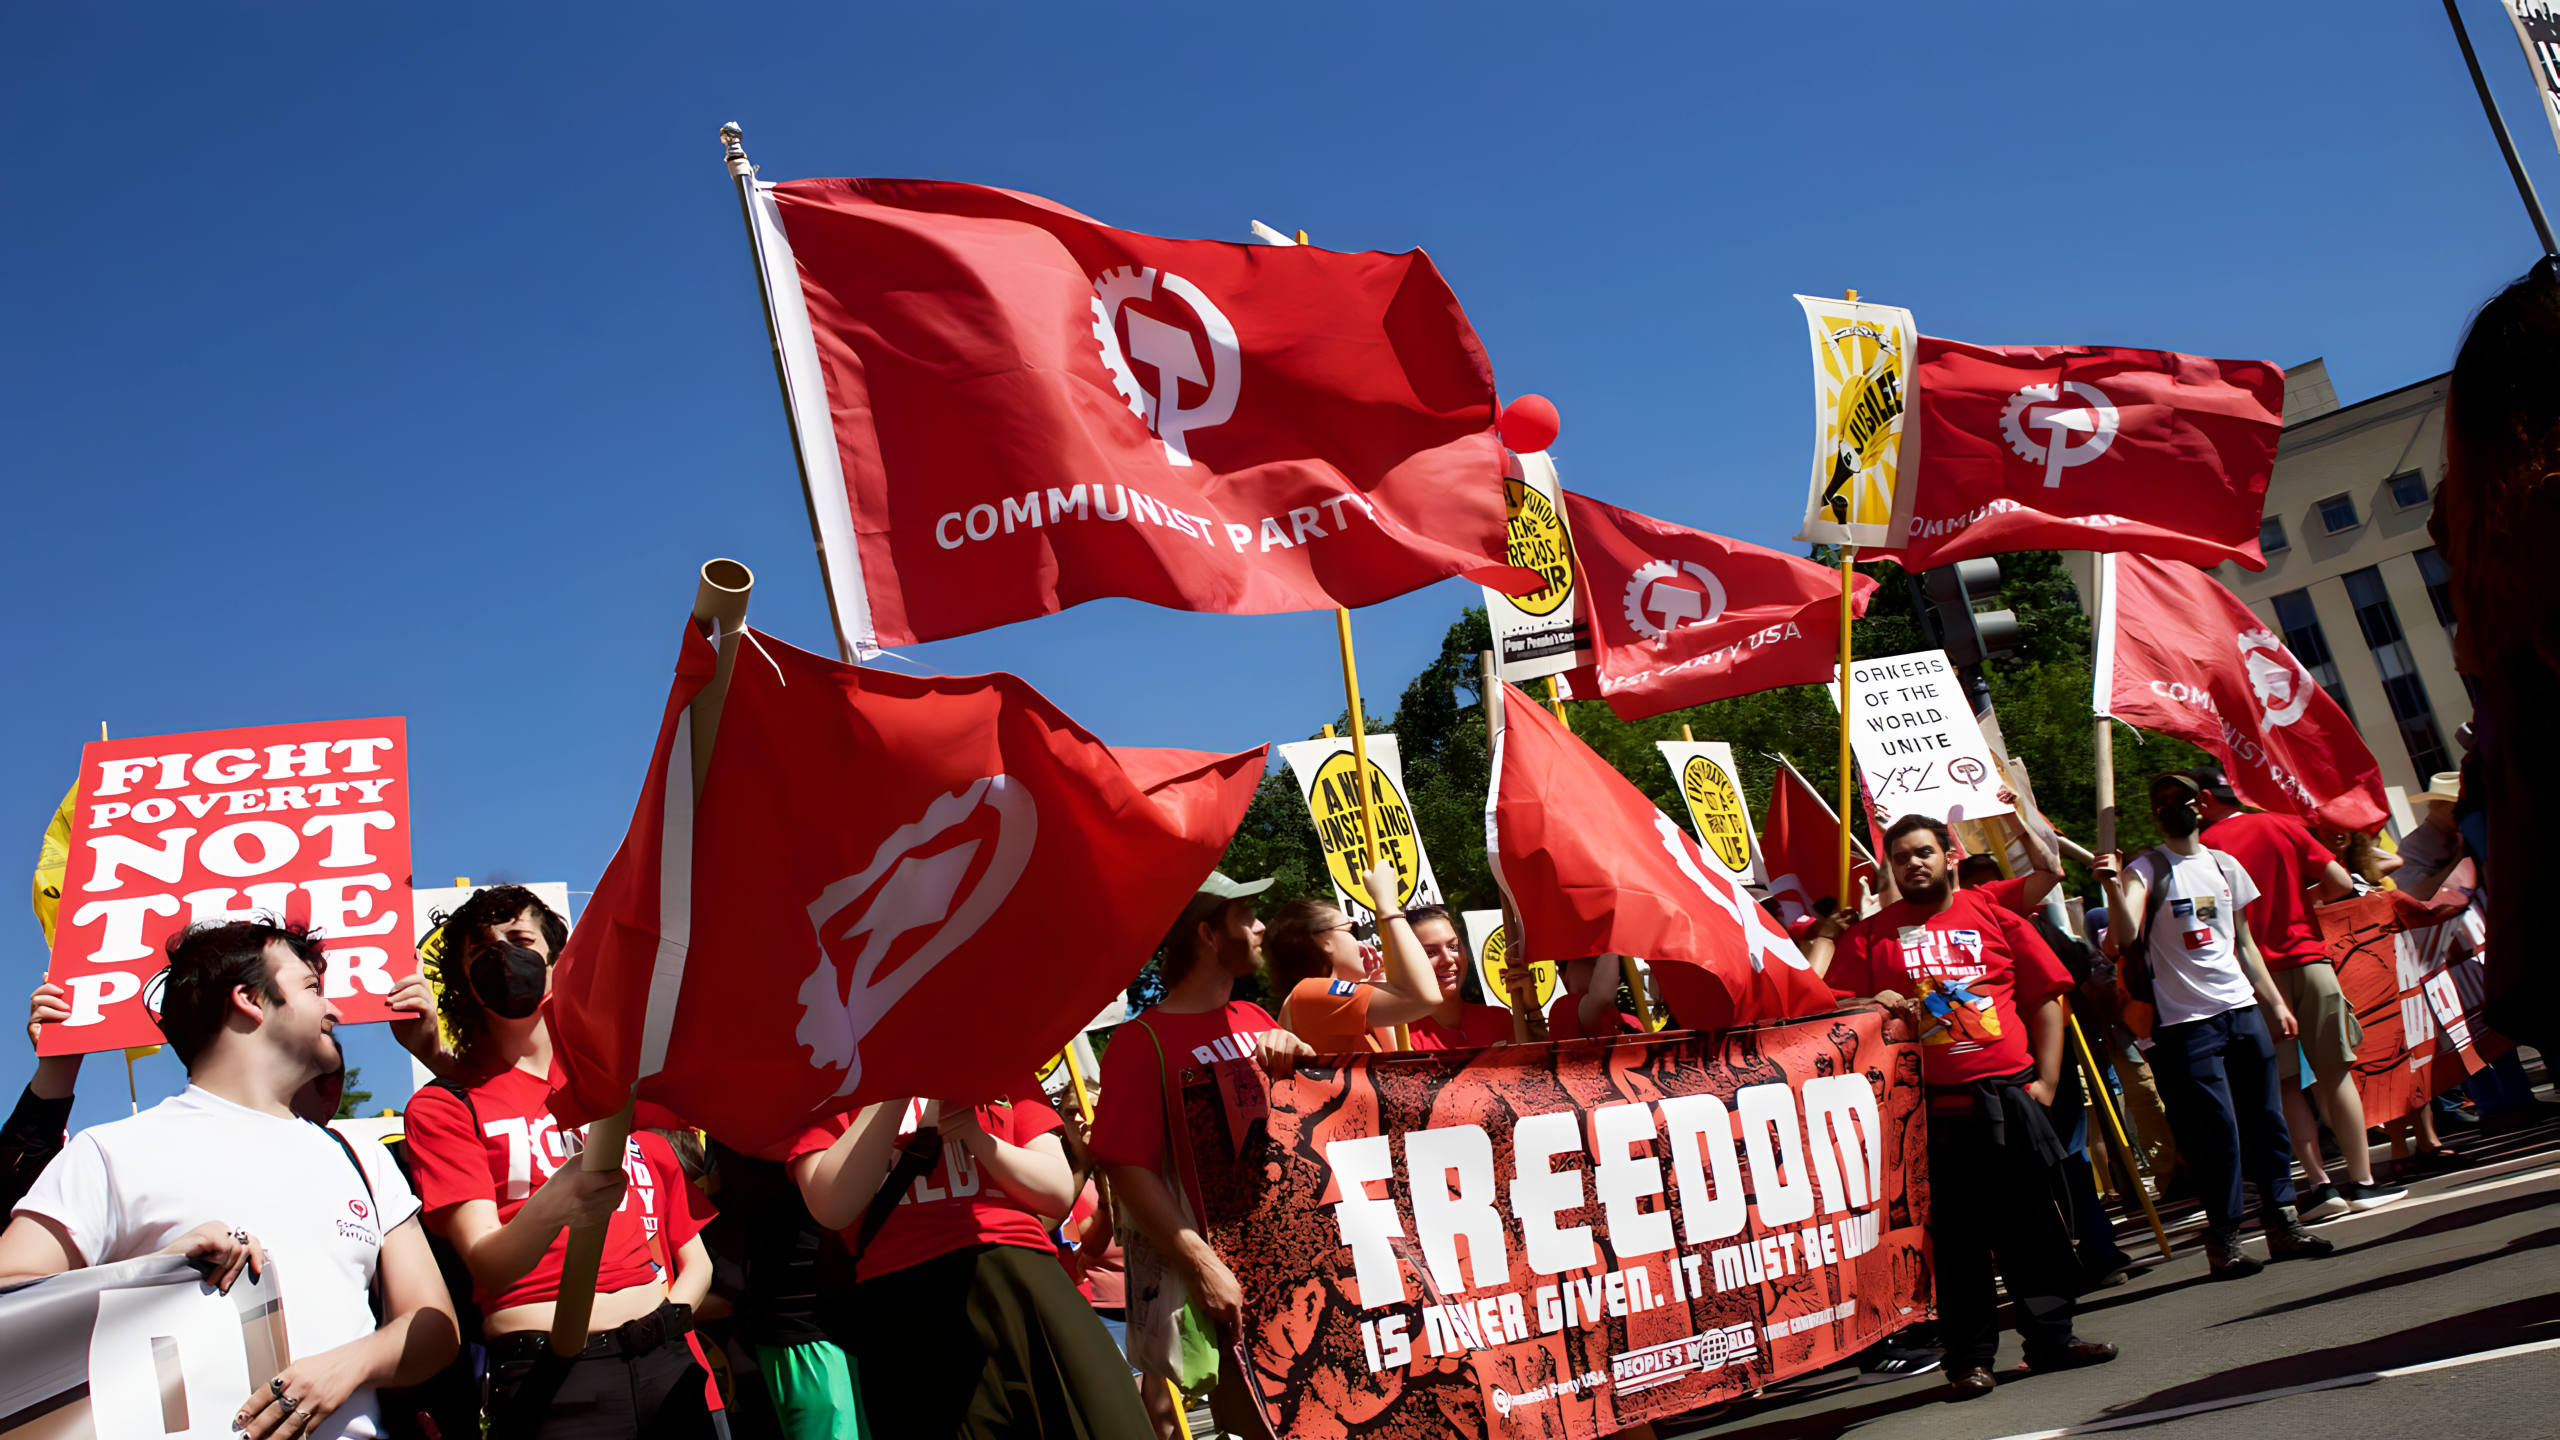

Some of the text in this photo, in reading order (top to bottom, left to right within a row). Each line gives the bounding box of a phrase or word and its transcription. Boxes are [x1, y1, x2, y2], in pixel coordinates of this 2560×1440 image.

[936, 484, 1215, 549] COMMUNIST
[1854, 659, 1944, 683] ORKERS
[1865, 684, 1939, 707] OF THE
[93, 737, 394, 796] FIGHT
[1881, 733, 1951, 756] UNITE
[89, 778, 395, 829] POVERTY
[1321, 777, 1343, 815] A
[82, 810, 396, 892] NOT
[1320, 805, 1410, 853] UNSELING
[72, 872, 398, 963] THE
[61, 946, 396, 1026] PR
[1325, 1072, 1882, 1309] FREEDOM
[1360, 1314, 1412, 1373] IS
[1536, 1266, 1665, 1334] GIVEN.
[1670, 1254, 1702, 1303] IT
[1711, 1232, 1796, 1293] MUST
[1801, 1224, 1838, 1269] BE
[1612, 1346, 1683, 1381] PEOPLE'S
